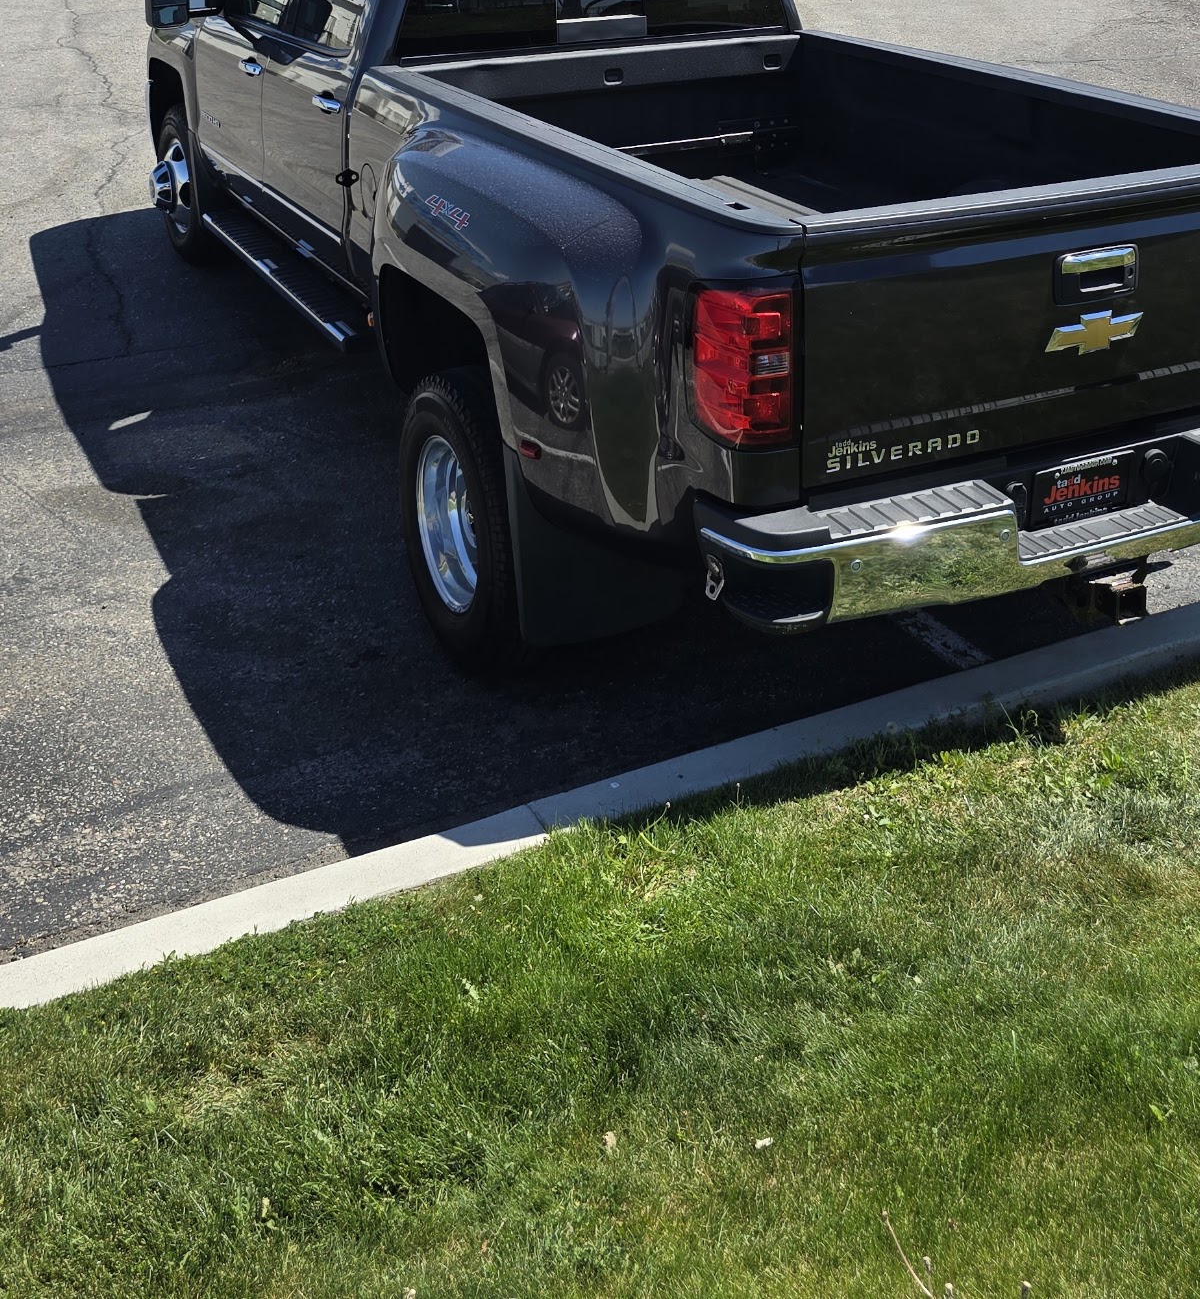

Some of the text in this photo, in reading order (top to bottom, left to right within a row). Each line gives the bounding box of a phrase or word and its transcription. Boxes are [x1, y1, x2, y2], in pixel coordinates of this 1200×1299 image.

[425, 194, 470, 230] 4x4
[826, 429, 980, 473] SILVERADO
[828, 440, 877, 458] Jenkins
[836, 439, 850, 448] tadd
[1044, 474, 1120, 505] Jenkins
[1057, 474, 1081, 489] tadd
[1044, 491, 1118, 513] AUTO GROUP
